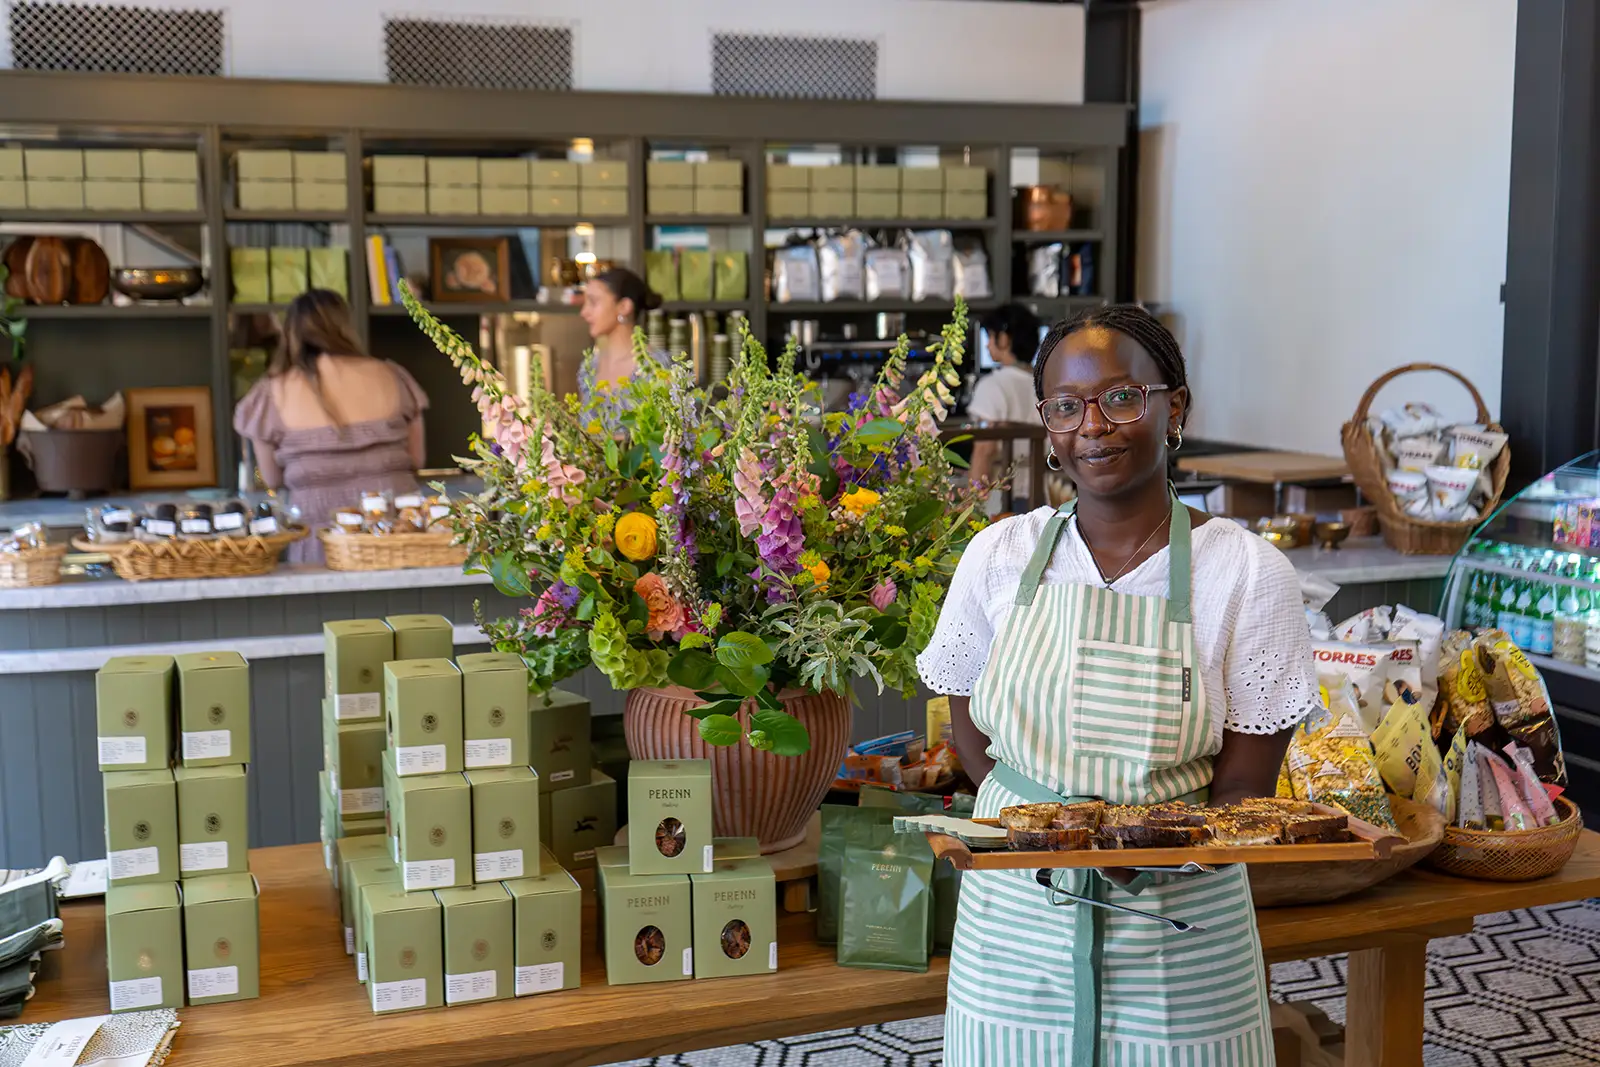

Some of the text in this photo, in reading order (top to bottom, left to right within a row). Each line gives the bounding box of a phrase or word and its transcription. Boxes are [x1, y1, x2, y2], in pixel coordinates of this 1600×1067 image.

[1313, 650, 1376, 666] TORRES
[648, 788, 691, 799] PERENN
[872, 863, 902, 873] PERENN
[626, 896, 670, 908] PERENN
[713, 890, 757, 902] PERENN
